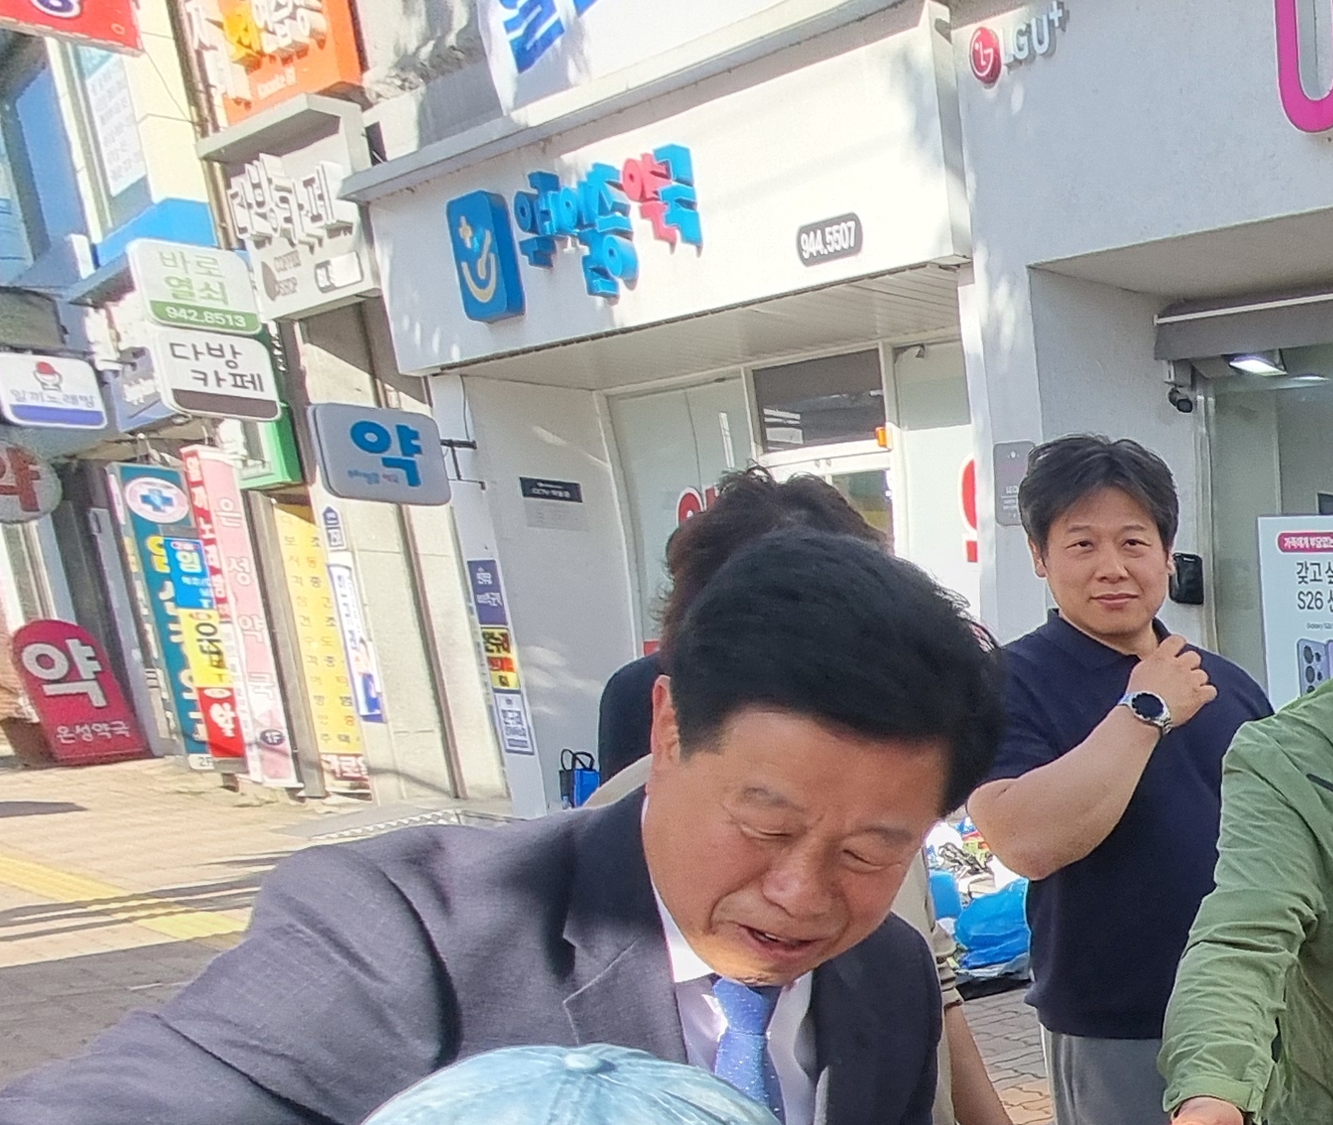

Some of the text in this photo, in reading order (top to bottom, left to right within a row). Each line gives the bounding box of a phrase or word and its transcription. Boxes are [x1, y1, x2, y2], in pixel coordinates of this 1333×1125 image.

[801, 221, 855, 258] 944.5507
[169, 342, 242, 369] 다방
[191, 369, 264, 392] 카페
[350, 421, 423, 487] 약
[1296, 561, 1322, 585] 갖고
[1297, 591, 1324, 610] S26
[22, 638, 108, 708] 약
[56, 720, 130, 744] 온성약국
